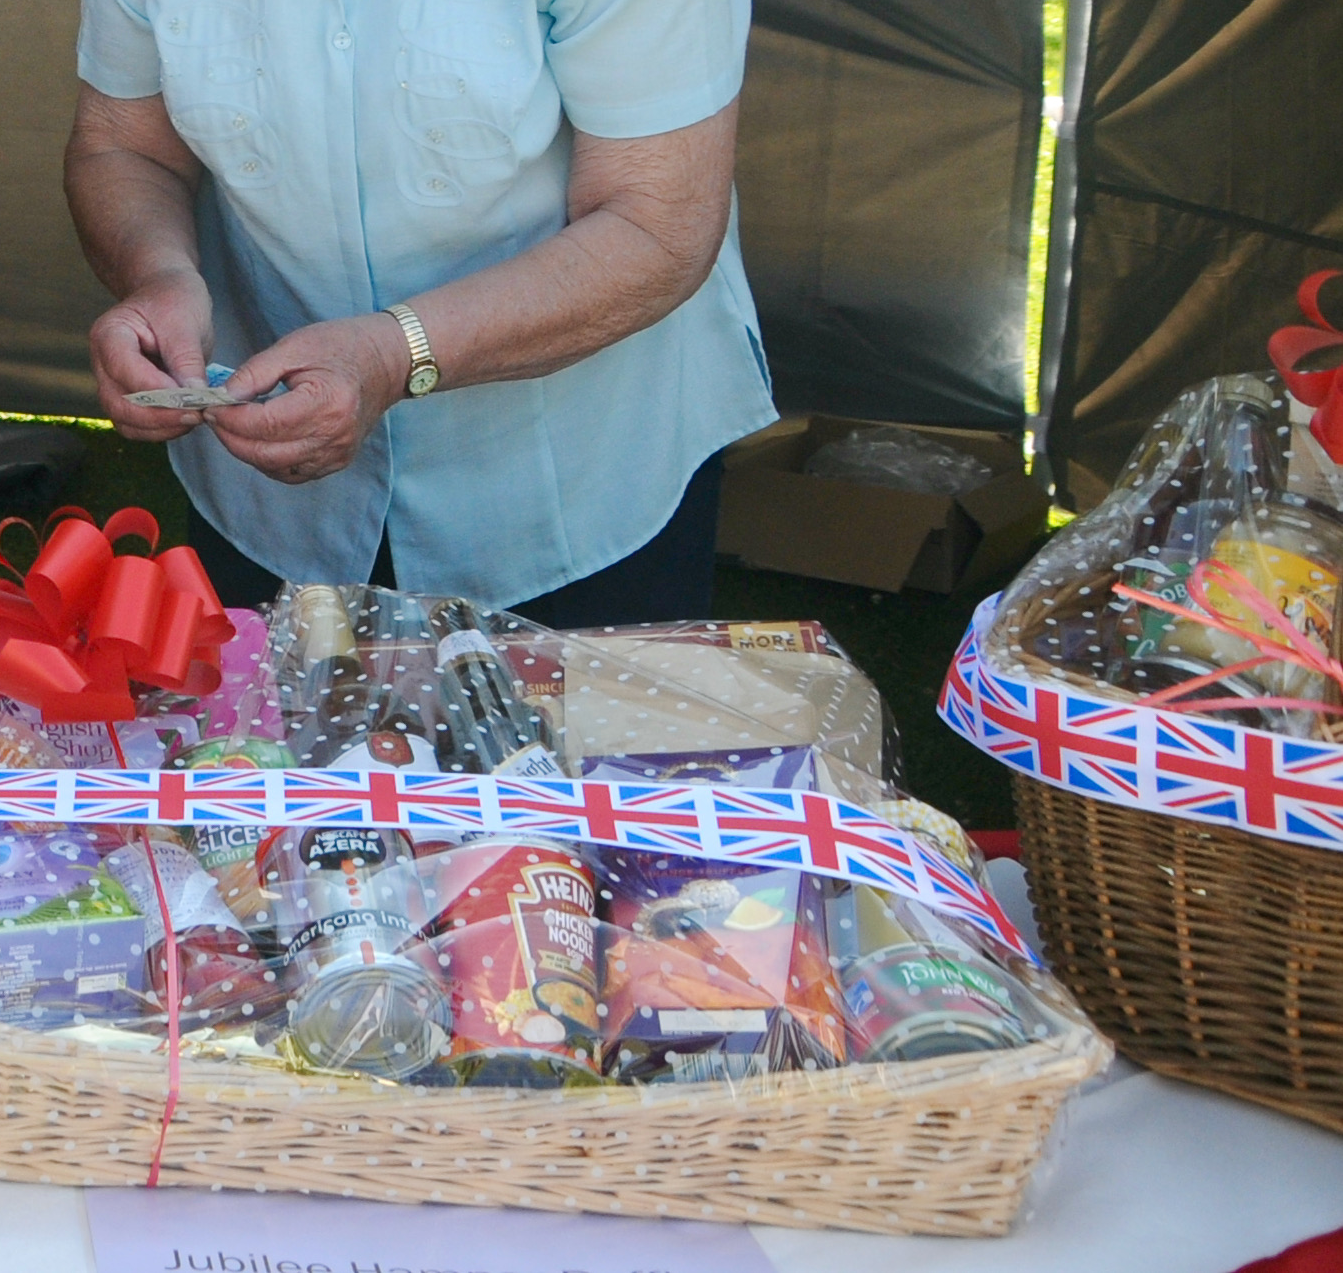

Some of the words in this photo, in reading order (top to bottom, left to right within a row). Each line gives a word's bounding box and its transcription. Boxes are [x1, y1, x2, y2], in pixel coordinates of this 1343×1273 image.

[526, 683, 566, 696] SINCE
[196, 828, 270, 858] SLICES
[309, 837, 381, 859] AZERA
[282, 909, 377, 967] americano
